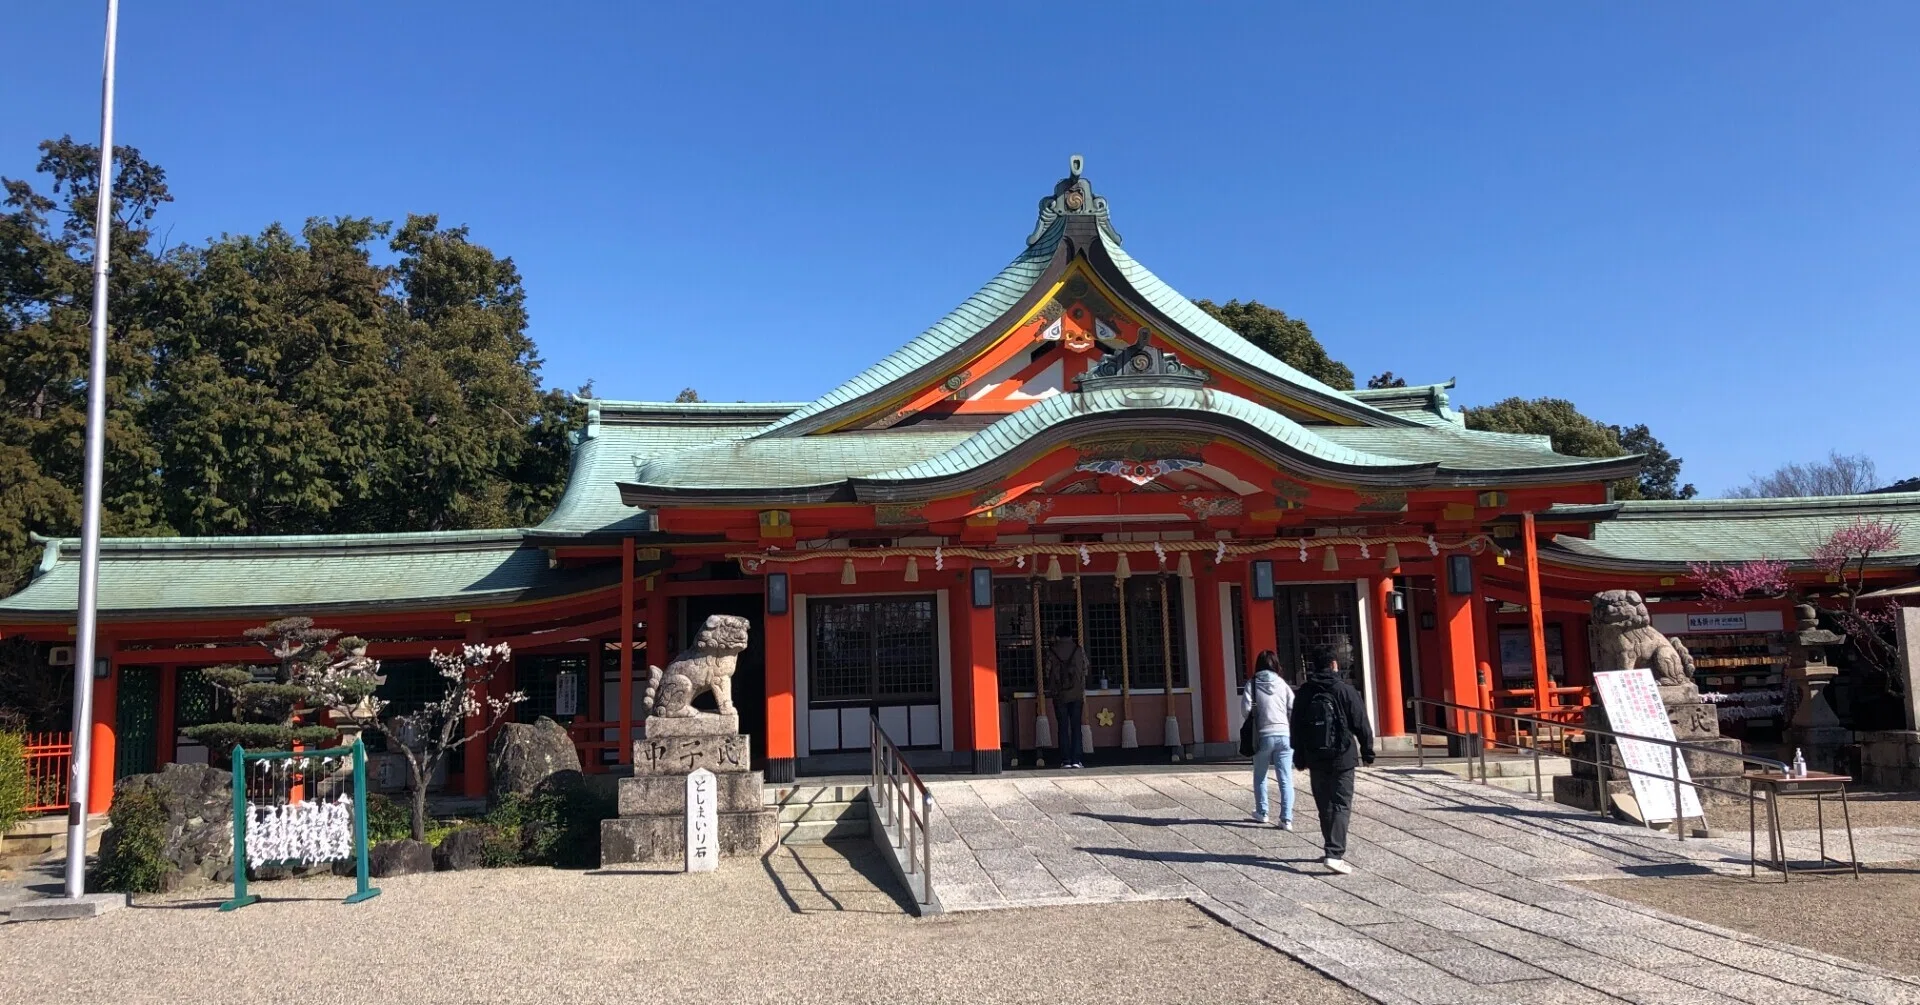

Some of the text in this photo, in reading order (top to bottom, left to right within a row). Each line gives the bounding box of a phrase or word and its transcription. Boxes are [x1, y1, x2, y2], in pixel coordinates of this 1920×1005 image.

[694, 776, 707, 858] としまいり石
